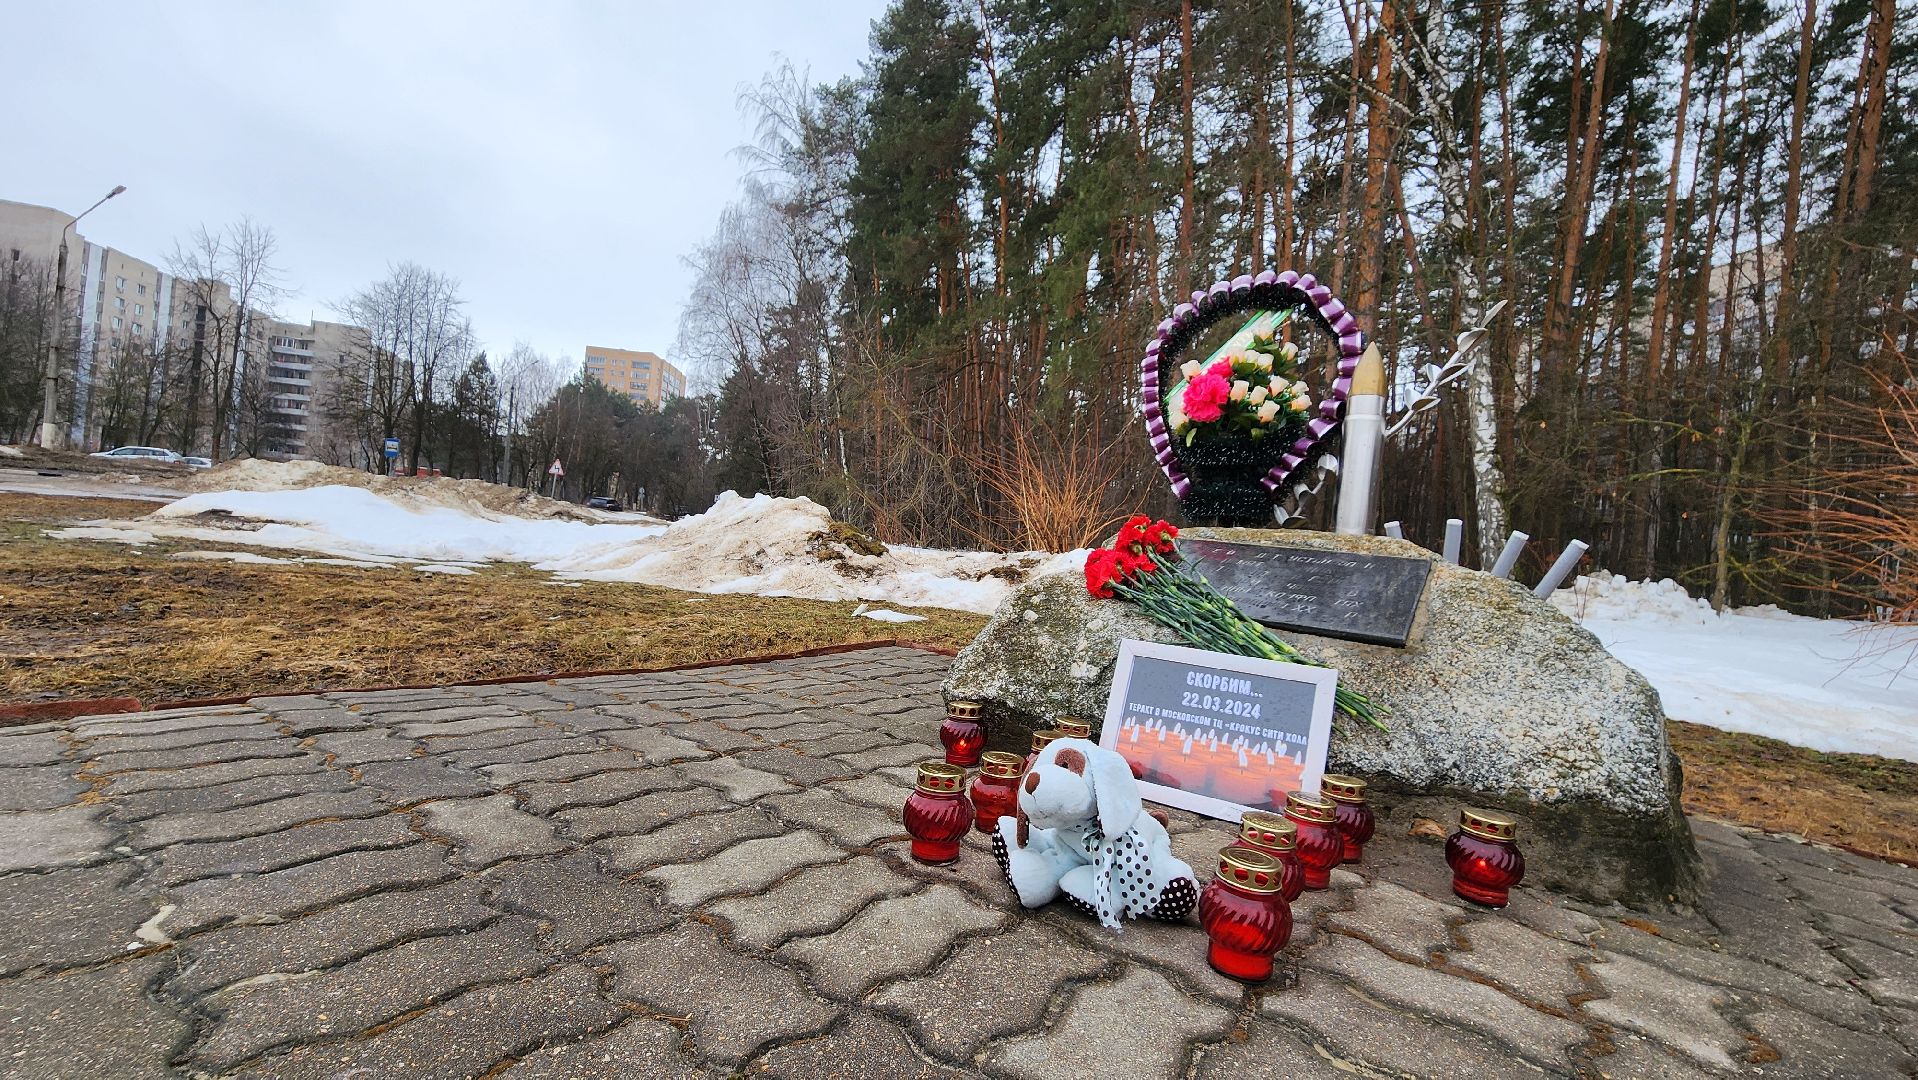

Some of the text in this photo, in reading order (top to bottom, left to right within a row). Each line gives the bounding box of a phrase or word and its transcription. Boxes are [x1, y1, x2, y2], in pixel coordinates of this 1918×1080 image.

[1186, 670, 1263, 698] СКОРБИМ...
[1181, 691, 1261, 719] 22.03.2024
[1129, 702, 1154, 715] ТЕРАКТ
[1155, 707, 1161, 716] В
[1161, 708, 1212, 726] МОСКОВСКОМ
[1213, 718, 1224, 729] ТЦ
[1262, 728, 1285, 741] СИТИ
